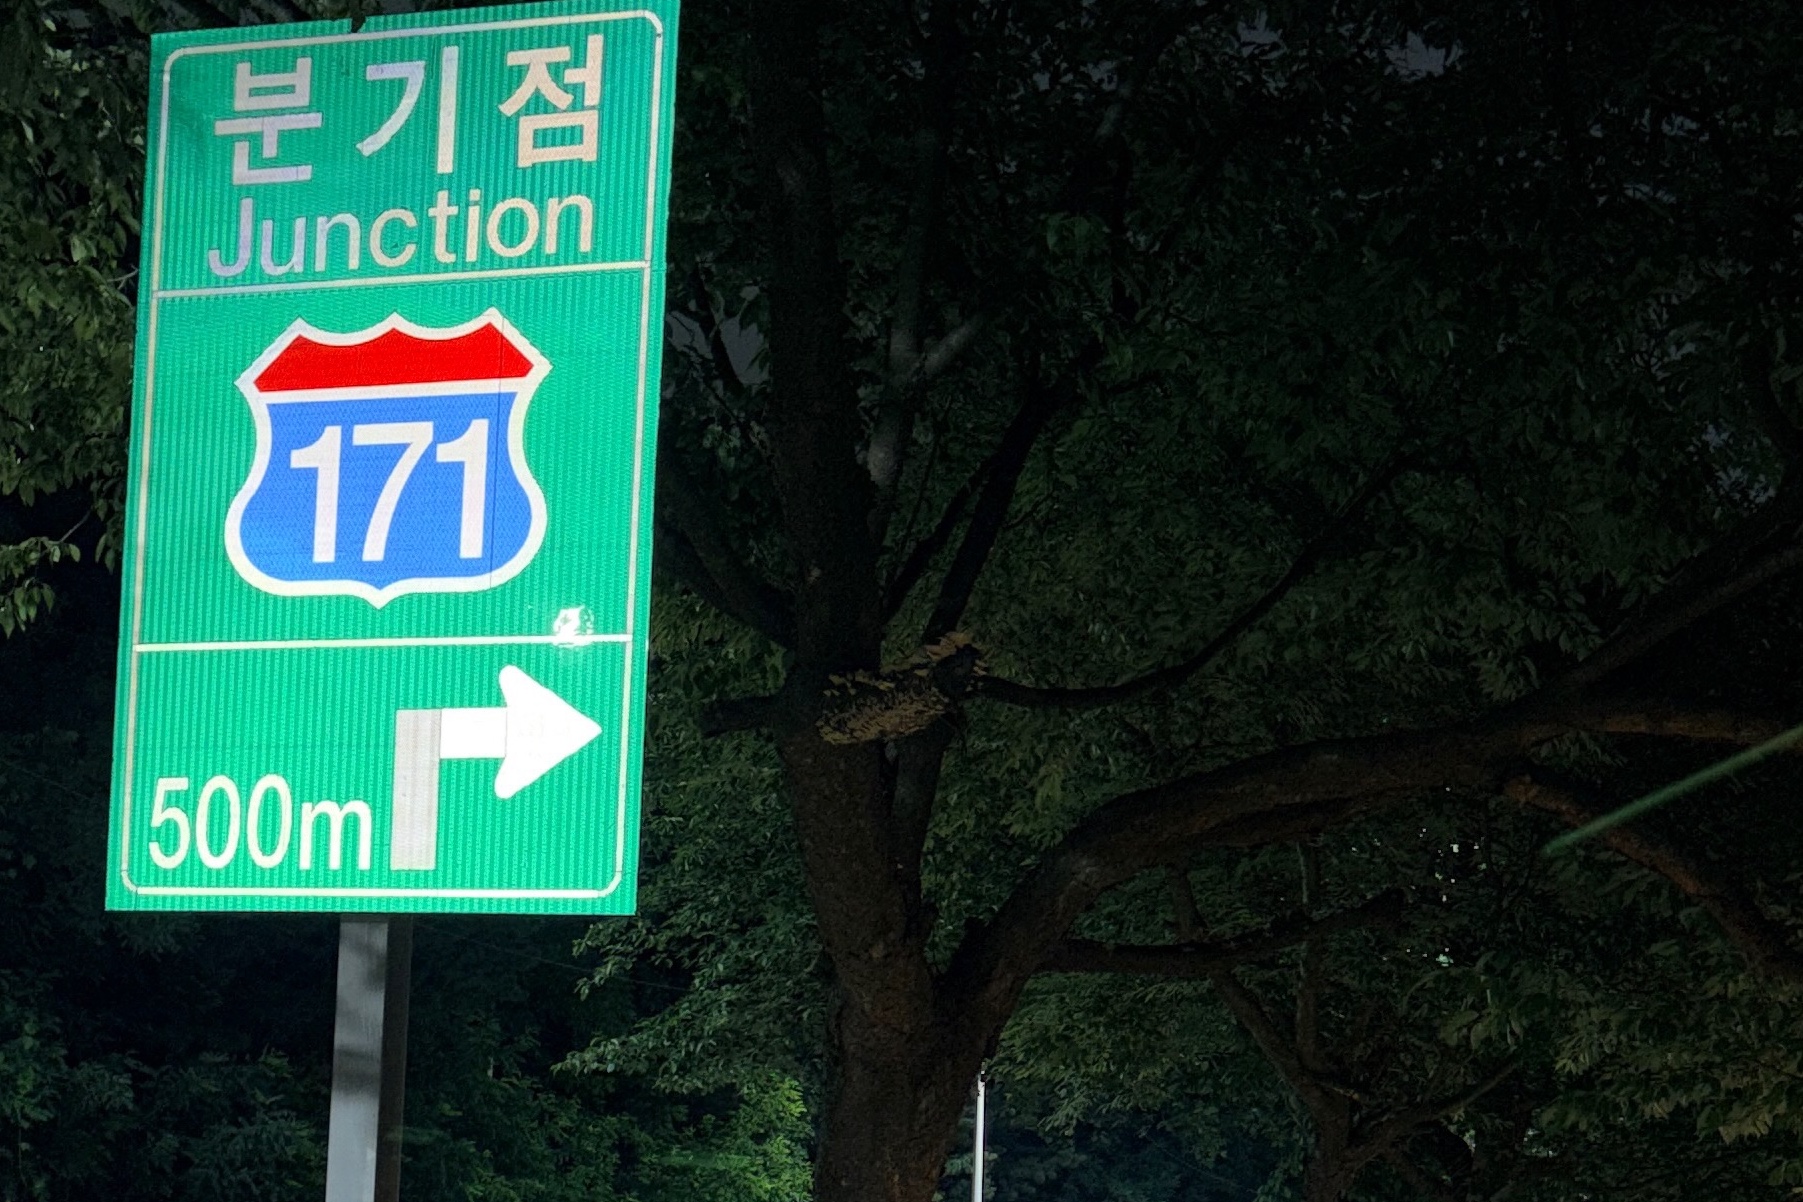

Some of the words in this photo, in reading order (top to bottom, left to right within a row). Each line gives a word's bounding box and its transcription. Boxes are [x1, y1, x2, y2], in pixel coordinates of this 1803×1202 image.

[213, 34, 605, 187] 분기점
[208, 188, 594, 278] Junction
[290, 419, 490, 564] 171
[148, 773, 372, 871] 500m
